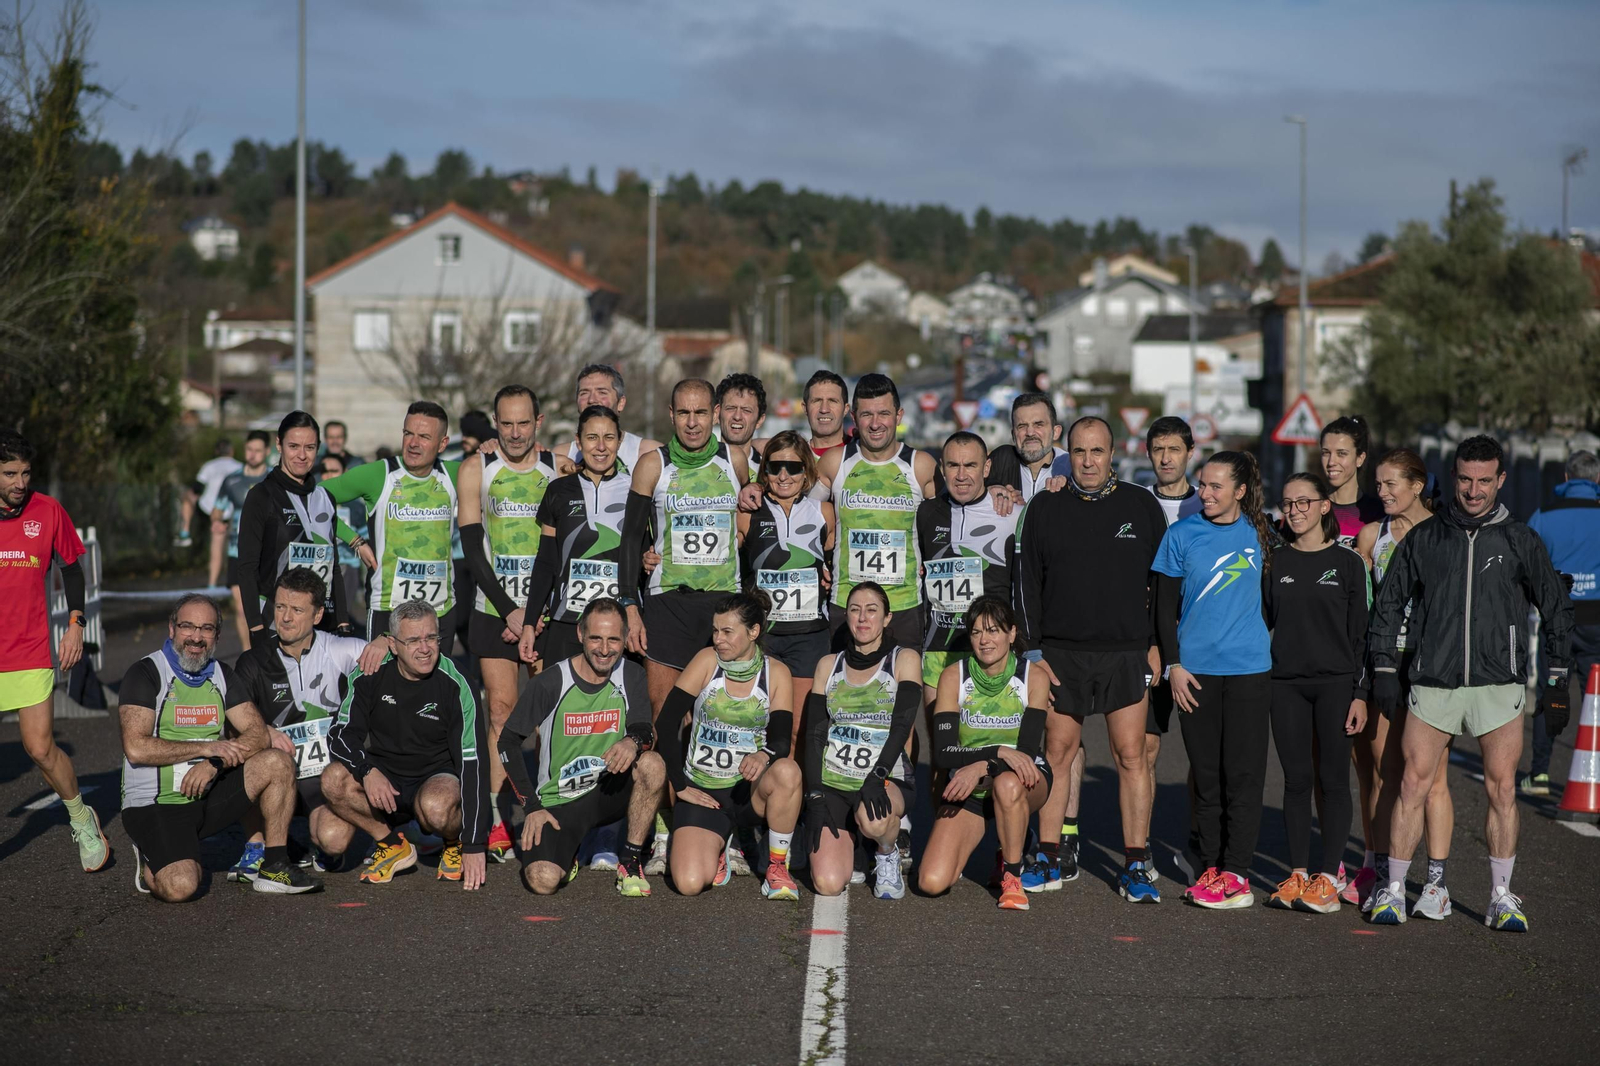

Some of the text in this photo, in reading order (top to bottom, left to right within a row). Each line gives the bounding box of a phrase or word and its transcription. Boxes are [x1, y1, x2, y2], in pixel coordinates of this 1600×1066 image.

[666, 494, 736, 511] Natursueño
[841, 489, 914, 509] Natursueño
[388, 502, 451, 520] Natursueño
[674, 515, 704, 526] XXII
[683, 531, 718, 554] 89
[852, 532, 879, 544] XXII
[292, 546, 315, 558] XXII
[399, 561, 426, 575] XXII
[497, 556, 519, 570] XXII
[854, 550, 897, 573] 141
[929, 561, 954, 574] XXII
[760, 572, 788, 584] XXII
[399, 580, 441, 602] 137
[570, 580, 619, 603] 229
[932, 578, 974, 601] 114
[772, 588, 801, 610] 91
[176, 706, 217, 716] mandarina
[566, 711, 618, 724] mandarina
[176, 715, 197, 724] home
[566, 724, 592, 735] home
[700, 727, 727, 743] XXII
[832, 725, 859, 740] XXII
[835, 743, 873, 768] 48
[564, 758, 590, 777] XXII
